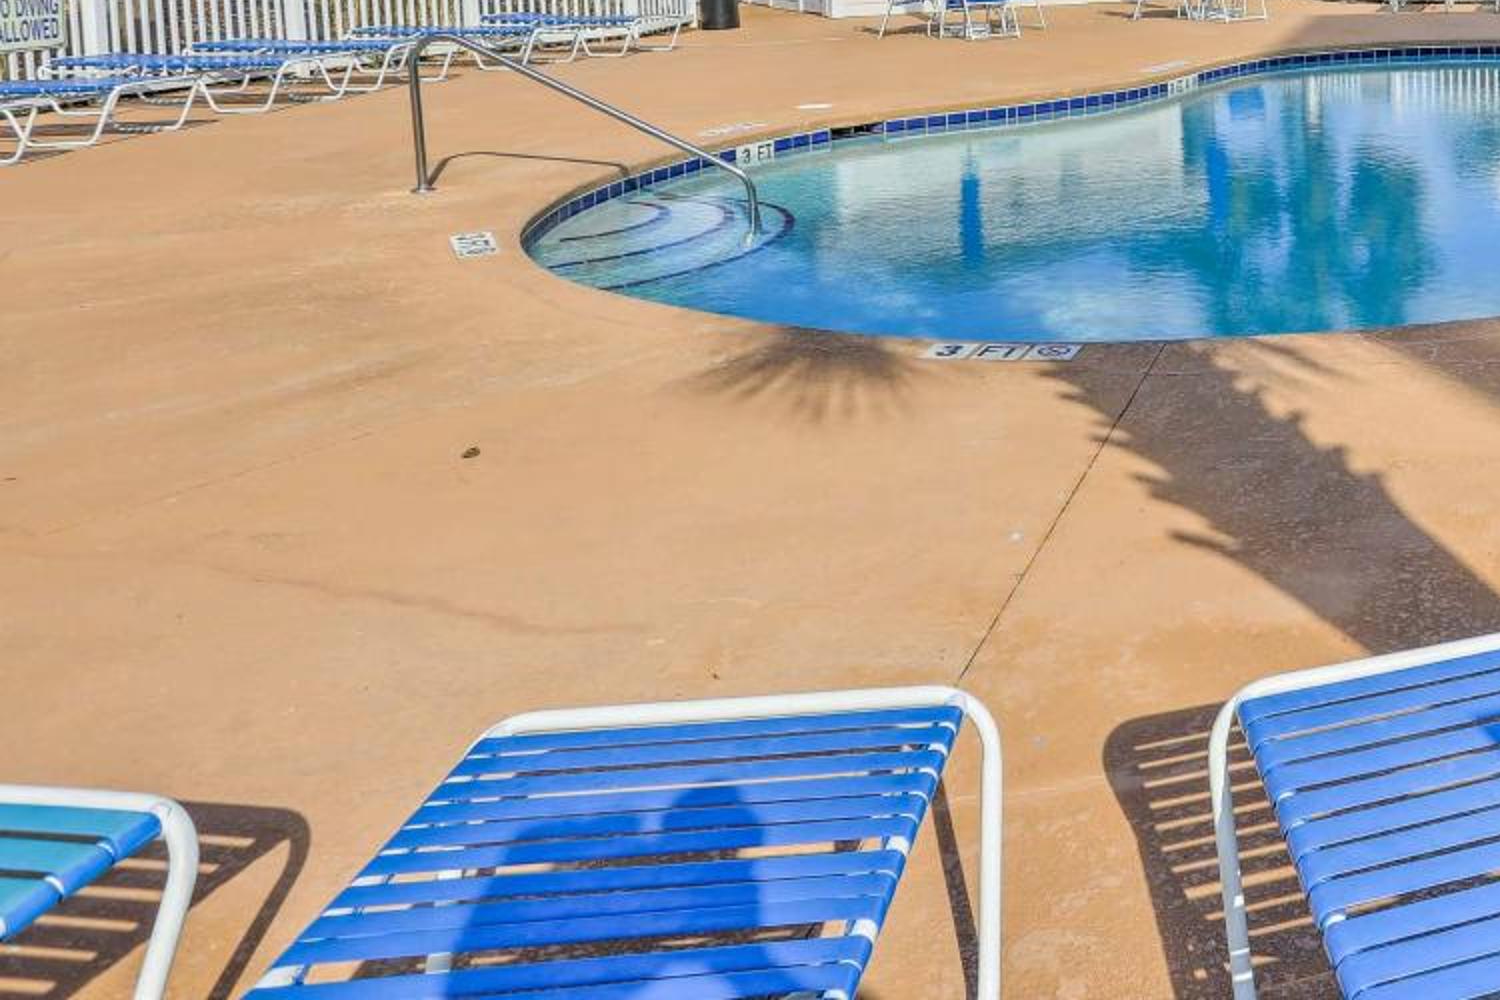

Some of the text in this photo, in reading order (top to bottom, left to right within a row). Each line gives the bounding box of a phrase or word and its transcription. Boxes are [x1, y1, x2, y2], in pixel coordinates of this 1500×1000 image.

[742, 143, 772, 164] 3 FT
[935, 345, 1017, 358] 3 FT
